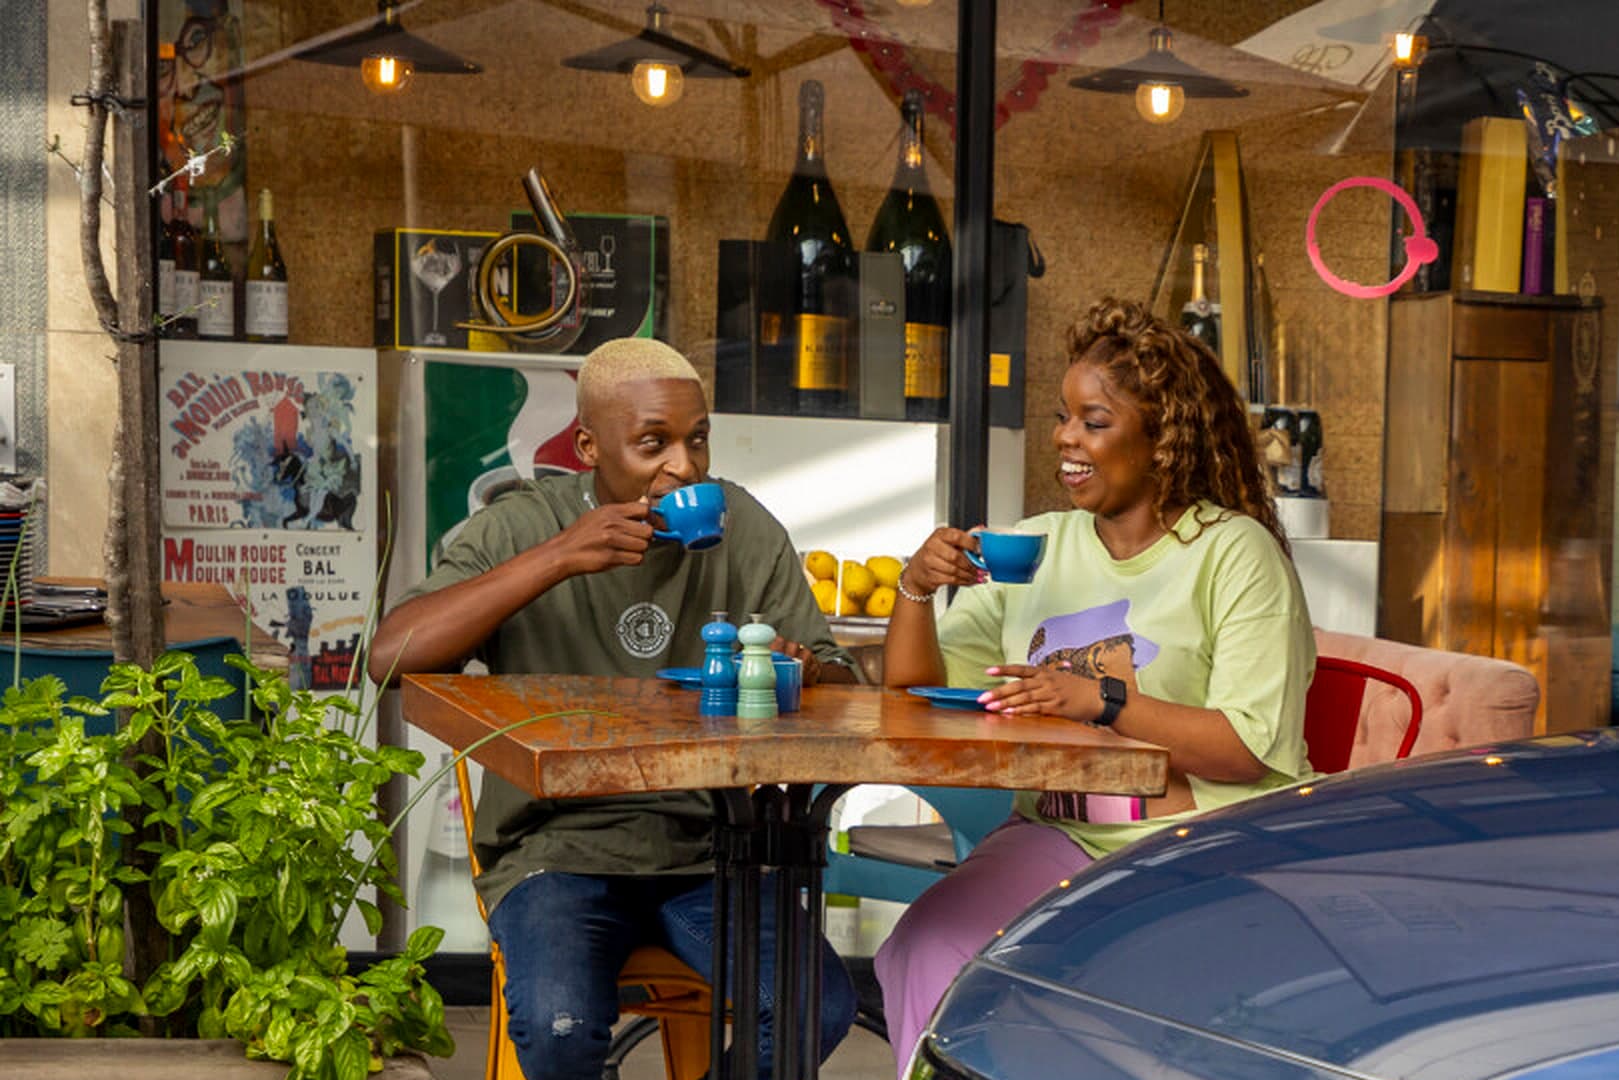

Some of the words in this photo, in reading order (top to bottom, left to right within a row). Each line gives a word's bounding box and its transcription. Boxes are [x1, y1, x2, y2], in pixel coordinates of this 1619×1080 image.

[166, 372, 206, 409] BAL
[188, 505, 229, 524] PARIS
[240, 545, 287, 563] ROUGE
[303, 559, 336, 575] BAL
[261, 592, 278, 601] LA
